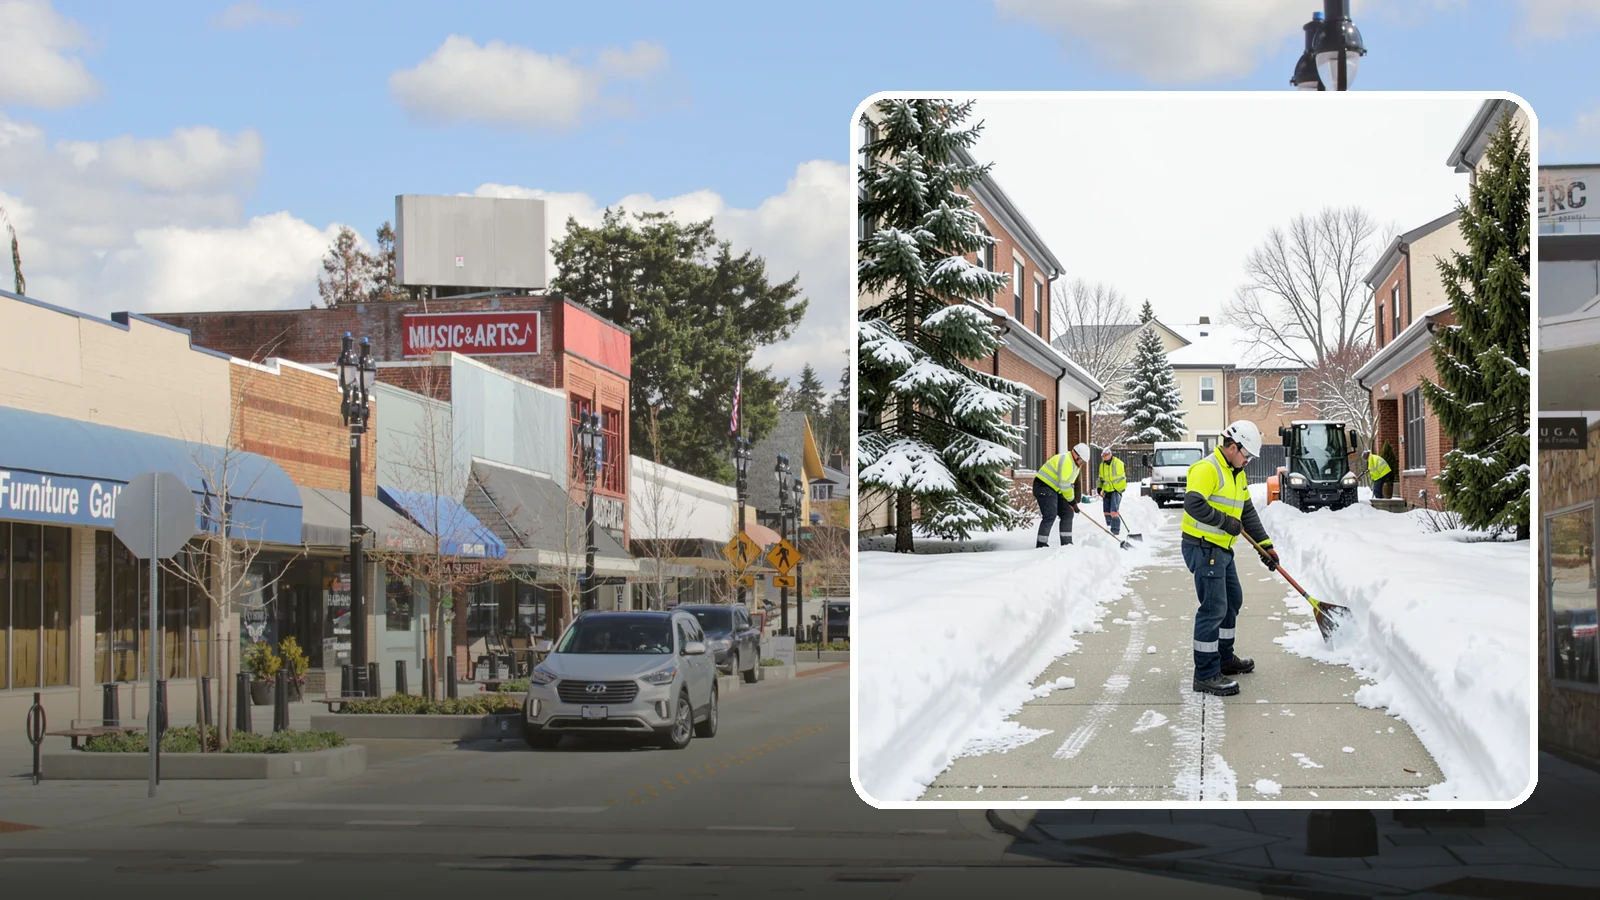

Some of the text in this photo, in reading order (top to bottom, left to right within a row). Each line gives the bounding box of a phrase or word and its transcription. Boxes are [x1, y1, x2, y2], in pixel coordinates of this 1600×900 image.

[409, 322, 519, 348] MUSIC&ARTS
[0, 471, 122, 519] Furniture Gal
